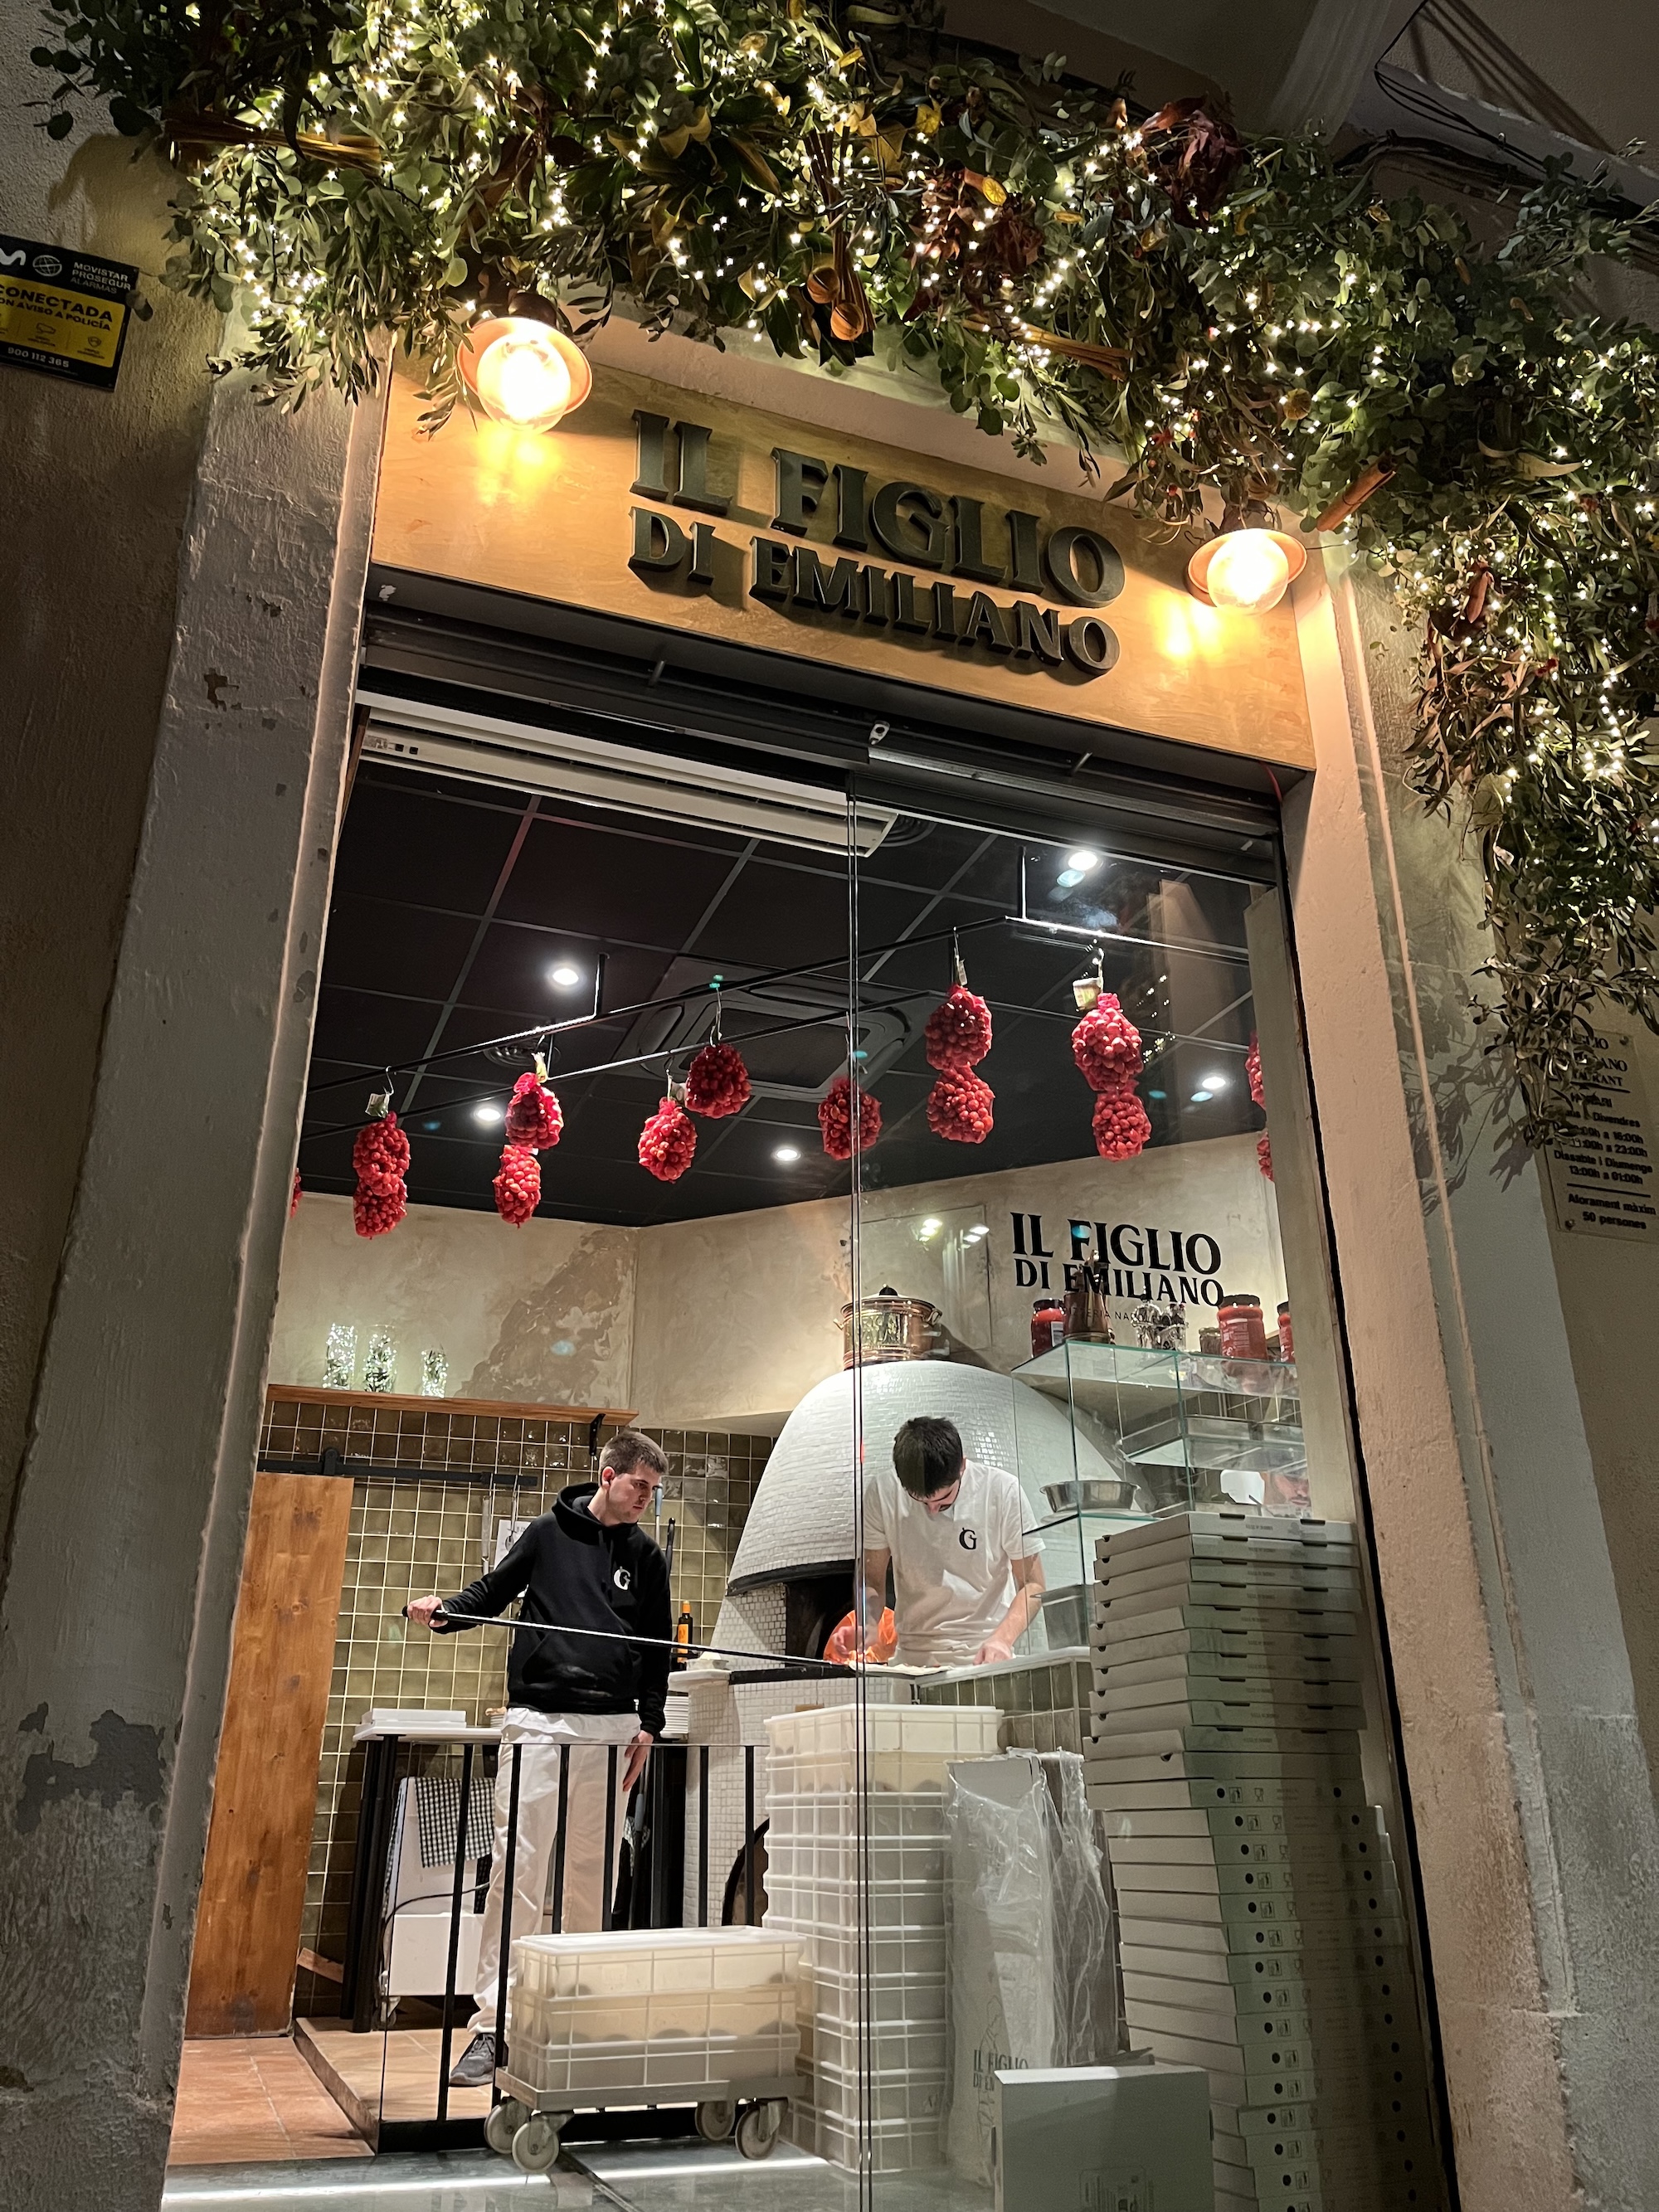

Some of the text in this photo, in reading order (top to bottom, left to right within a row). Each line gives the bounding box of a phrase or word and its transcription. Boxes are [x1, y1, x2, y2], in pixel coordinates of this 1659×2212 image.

[72, 270, 131, 291] PROSEGUR
[74, 261, 129, 282] MOVISTAR
[71, 276, 117, 294] ALARMAS
[0, 297, 111, 332] ON AVISO A POLICÍA
[7, 346, 29, 358] 900
[32, 351, 46, 362] 112
[48, 357, 70, 368] 365
[630, 409, 1126, 609] IL FIGLIO
[628, 506, 1121, 677] DI EMILIANO
[1593, 1111, 1641, 1128] Divendres
[1603, 1131, 1610, 1140] a
[1554, 1150, 1597, 1165] Dissabte
[1605, 1157, 1653, 1174] Diumenge
[1606, 1145, 1613, 1153] a
[1614, 1144, 1648, 1158] 23:00h
[1569, 1165, 1601, 1179] 13:00h
[1603, 1172, 1609, 1180] a
[1568, 1193, 1657, 1216] Aforament màxim
[1583, 1211, 1647, 1230] 50 persones
[1010, 1212, 1222, 1275] IL FIGLIO
[1014, 1258, 1225, 1307] DI EMILIANO
[973, 2049, 984, 2073] IL
